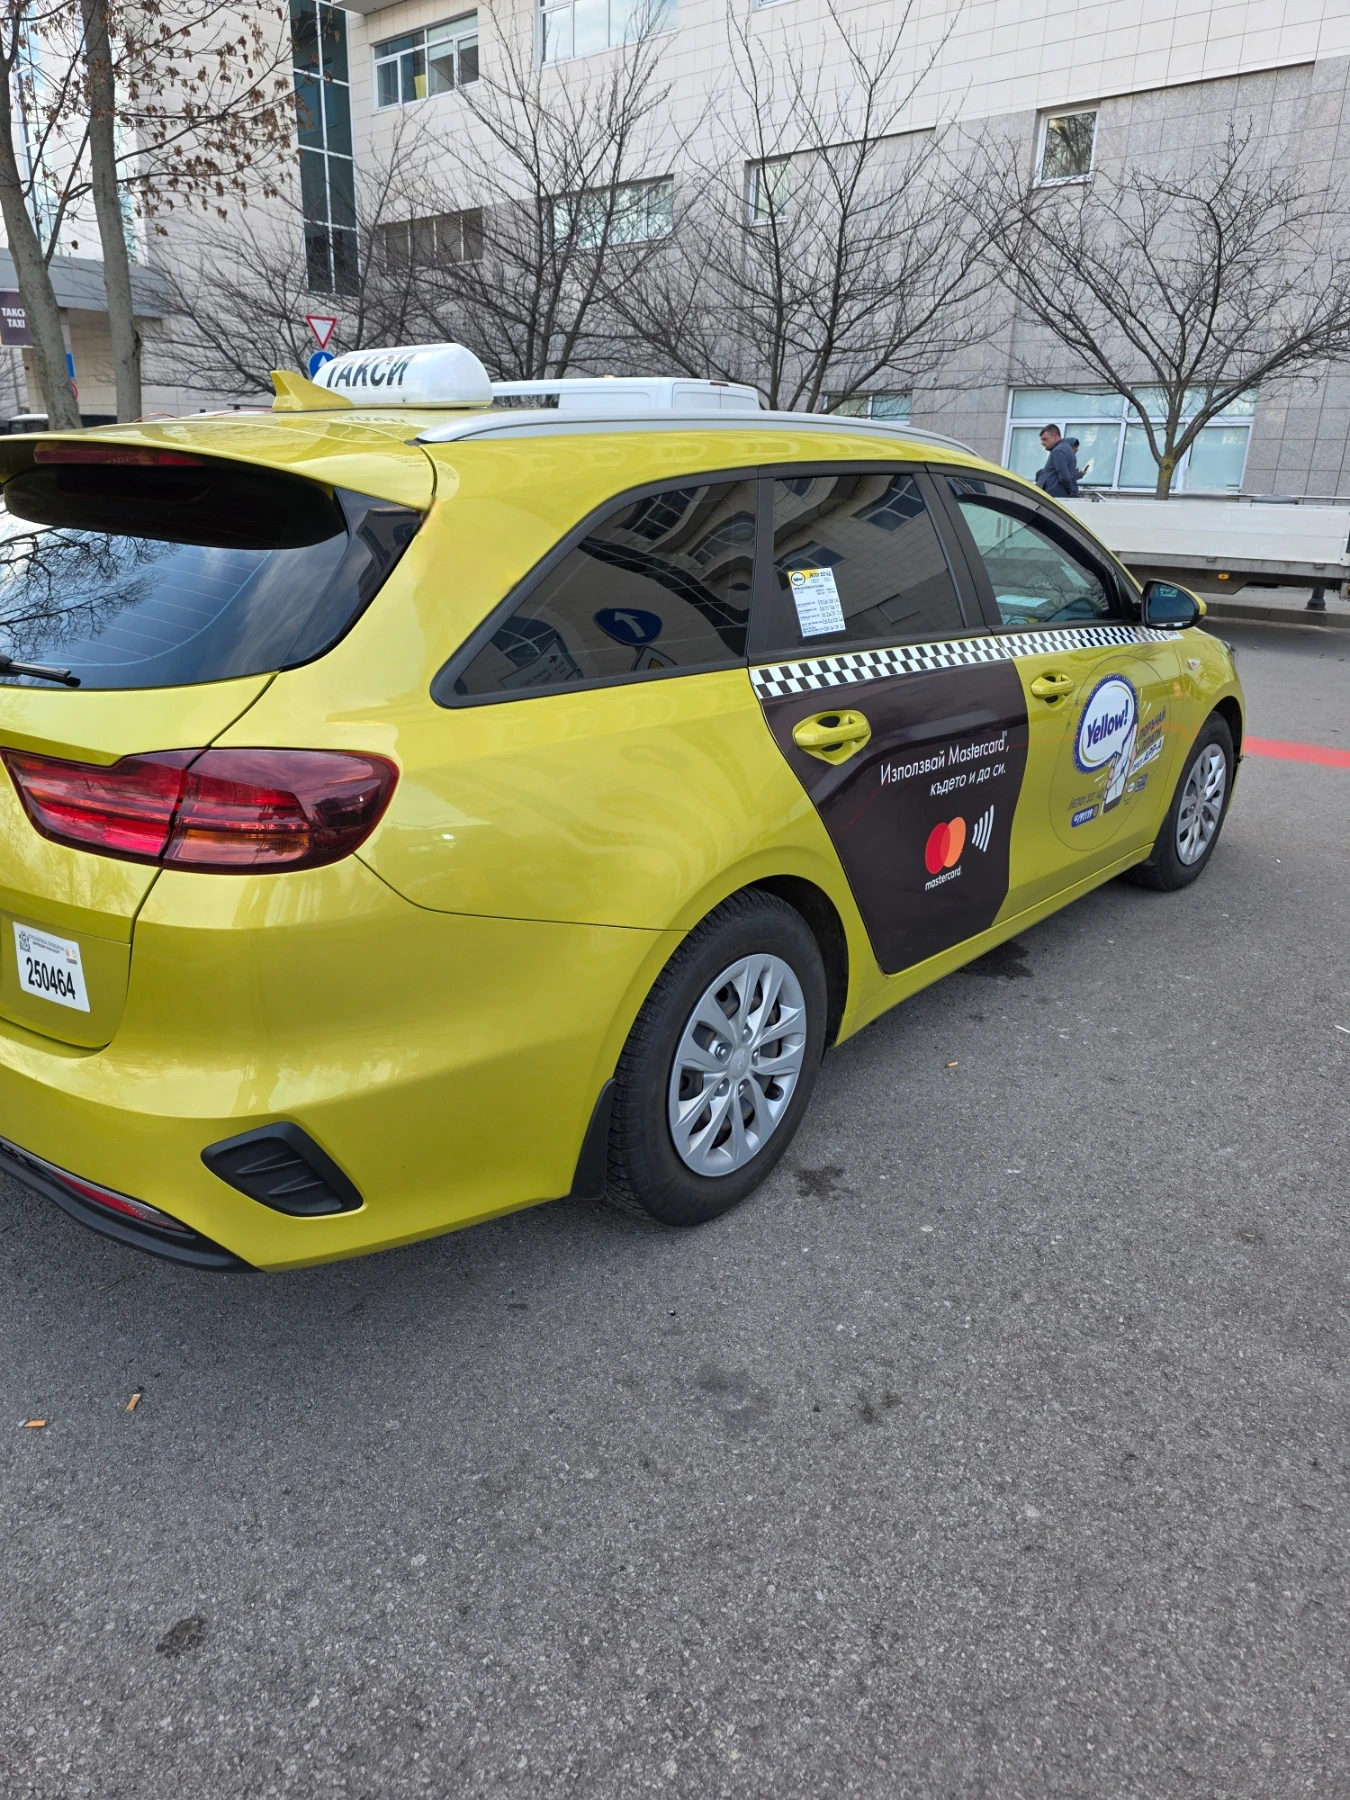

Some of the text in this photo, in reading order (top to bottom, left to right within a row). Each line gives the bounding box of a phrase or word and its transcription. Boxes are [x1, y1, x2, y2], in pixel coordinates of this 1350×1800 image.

[7, 318, 26, 329] TAXI
[326, 353, 417, 388] ТАКСИ
[1085, 699, 1130, 749] Yellow!
[880, 750, 945, 786] Използвай
[929, 761, 1007, 797] където и да си.
[924, 865, 962, 891] mastercard
[26, 956, 76, 1000] 250464
